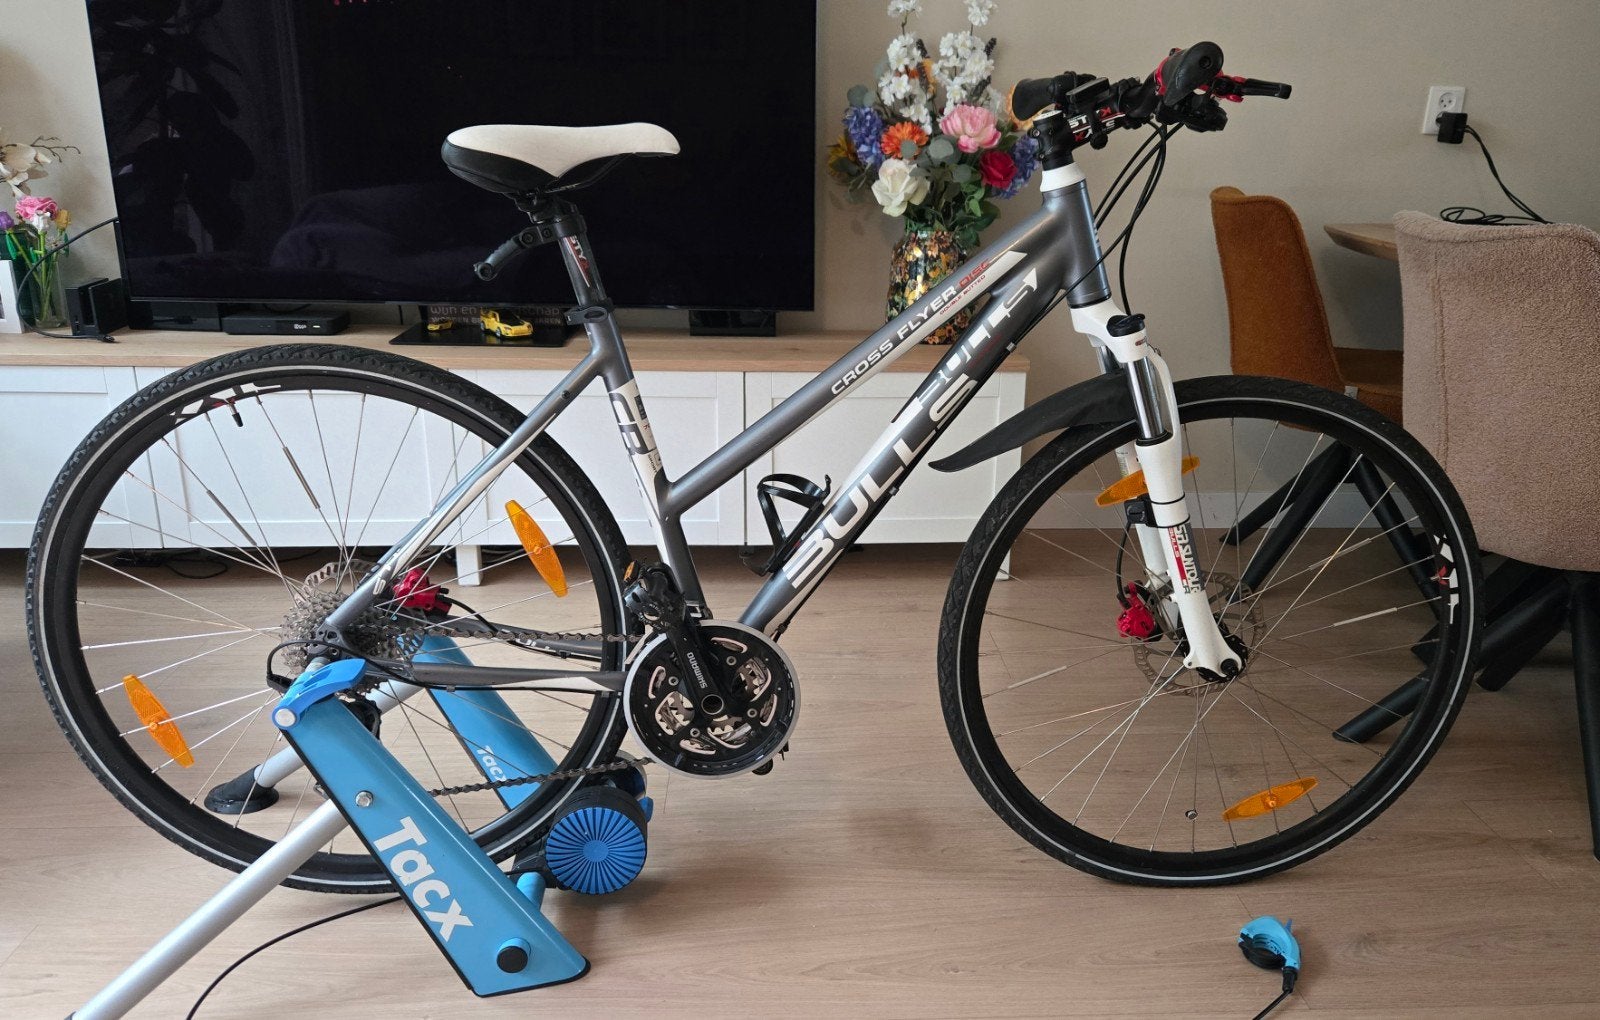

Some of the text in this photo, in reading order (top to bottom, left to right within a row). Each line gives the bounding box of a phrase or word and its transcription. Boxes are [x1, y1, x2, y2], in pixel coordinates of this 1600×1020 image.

[829, 257, 990, 396] CROSS FLYER DISC
[782, 373, 982, 589] BULLS
[686, 652, 708, 689] SHIMANO
[373, 817, 474, 942] Tacx
